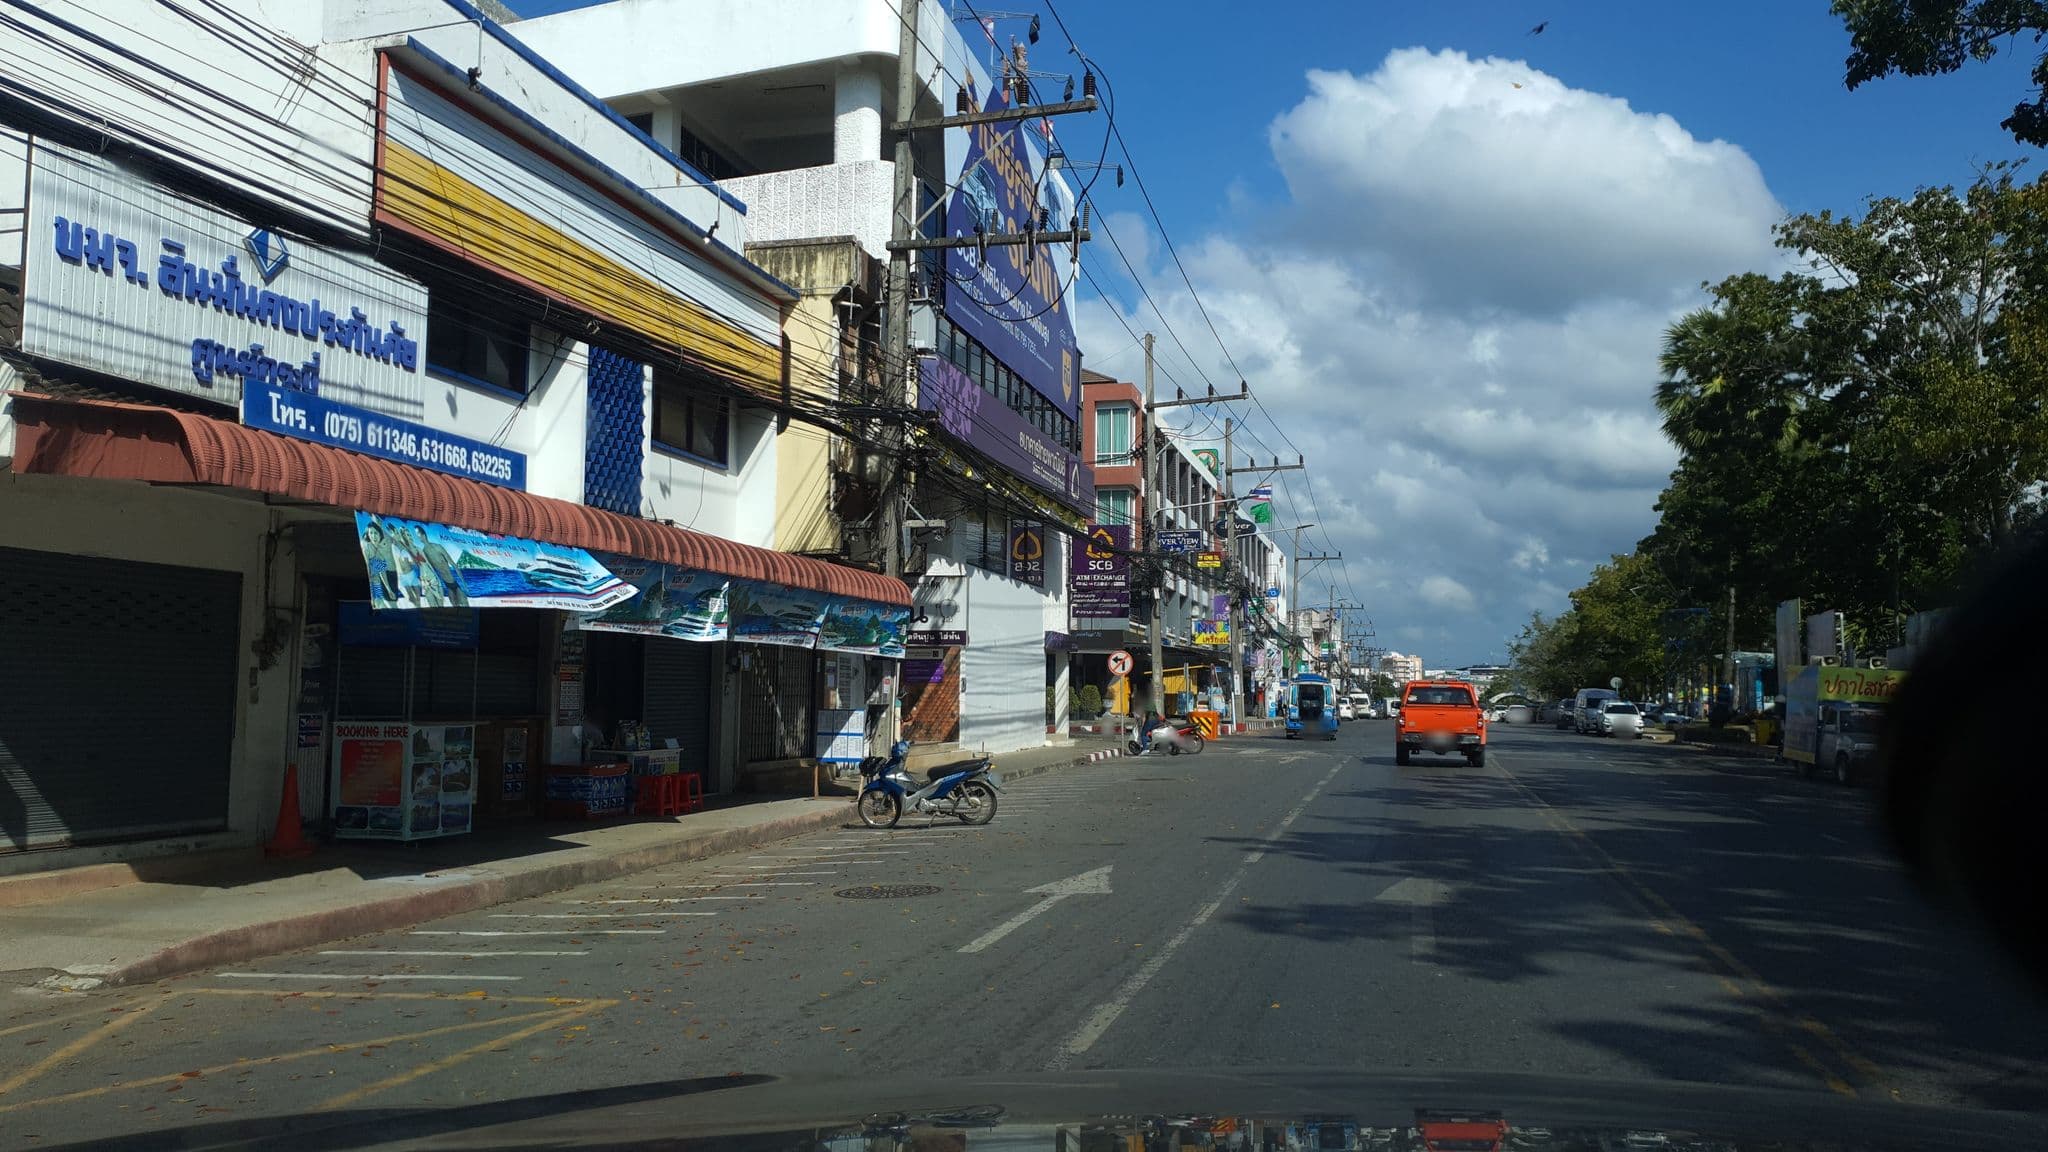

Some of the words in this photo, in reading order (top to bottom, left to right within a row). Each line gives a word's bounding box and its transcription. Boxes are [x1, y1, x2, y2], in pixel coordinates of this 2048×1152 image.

[54, 215, 148, 289] บมจ.
[158, 238, 418, 373] สินมั่นคงประกันภัย
[270, 393, 316, 433] โทร.
[324, 414, 363, 445] (075)
[366, 422, 512, 481] 611346,631668,632255
[1088, 560, 1113, 570] SCB
[336, 725, 379, 737] BOOKING
[384, 726, 408, 738] HERE
